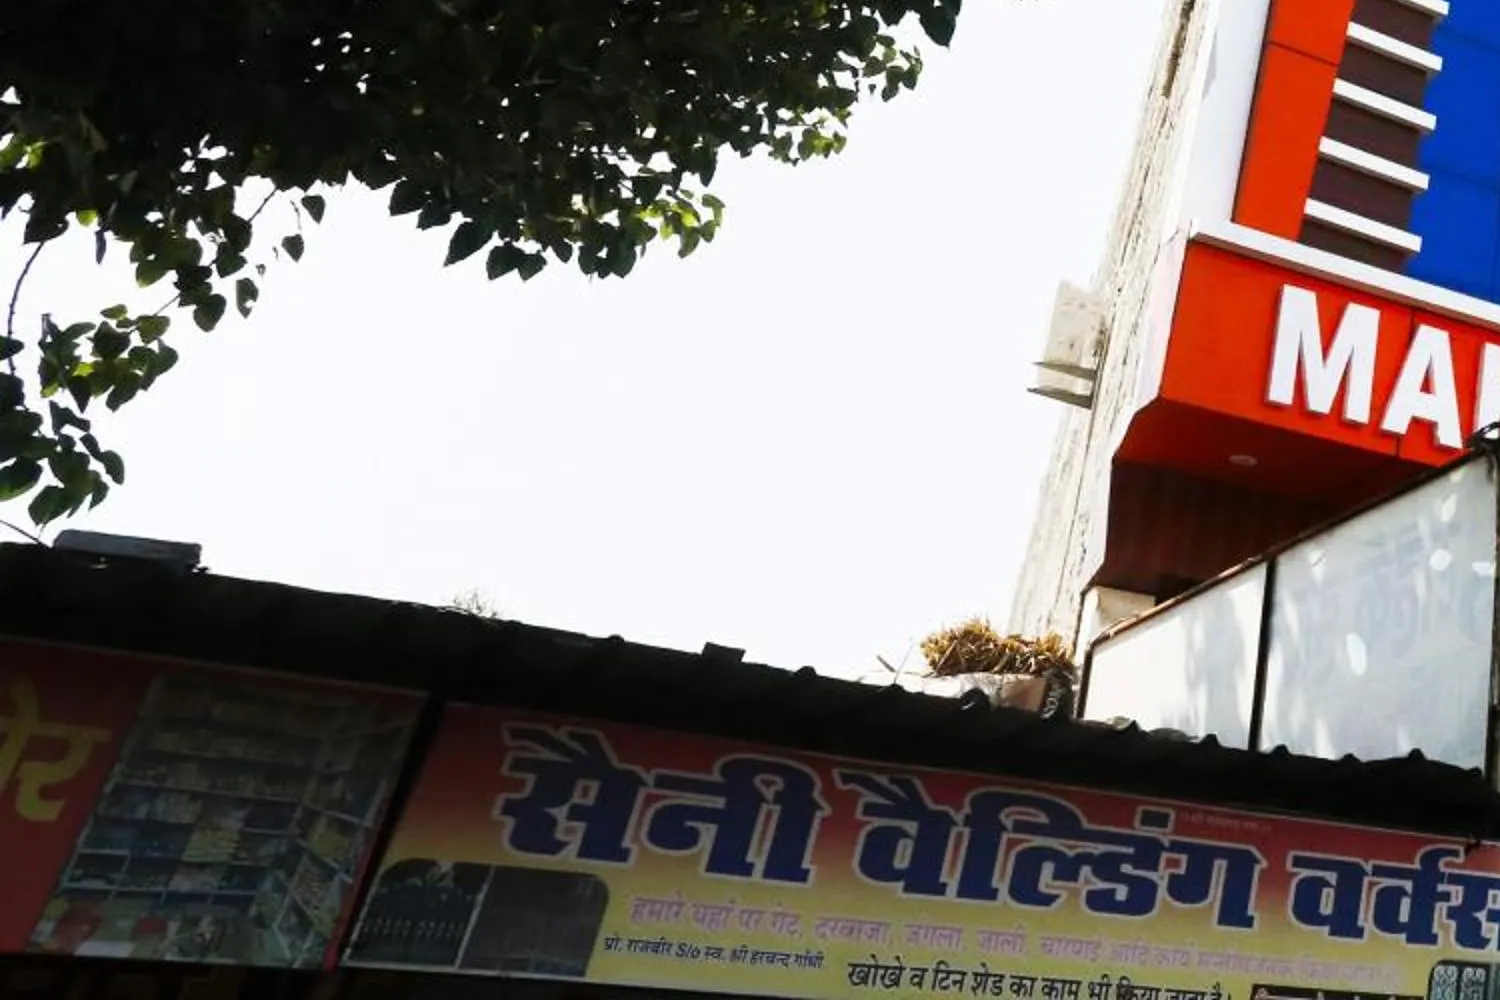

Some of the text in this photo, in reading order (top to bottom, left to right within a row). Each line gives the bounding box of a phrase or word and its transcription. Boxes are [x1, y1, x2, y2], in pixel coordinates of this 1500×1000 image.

[493, 722, 832, 888] सैनी
[737, 907, 765, 931] पर
[909, 967, 929, 991] व
[931, 960, 968, 992] टिन
[1009, 975, 1038, 998] का
[1040, 977, 1082, 1000] काम
